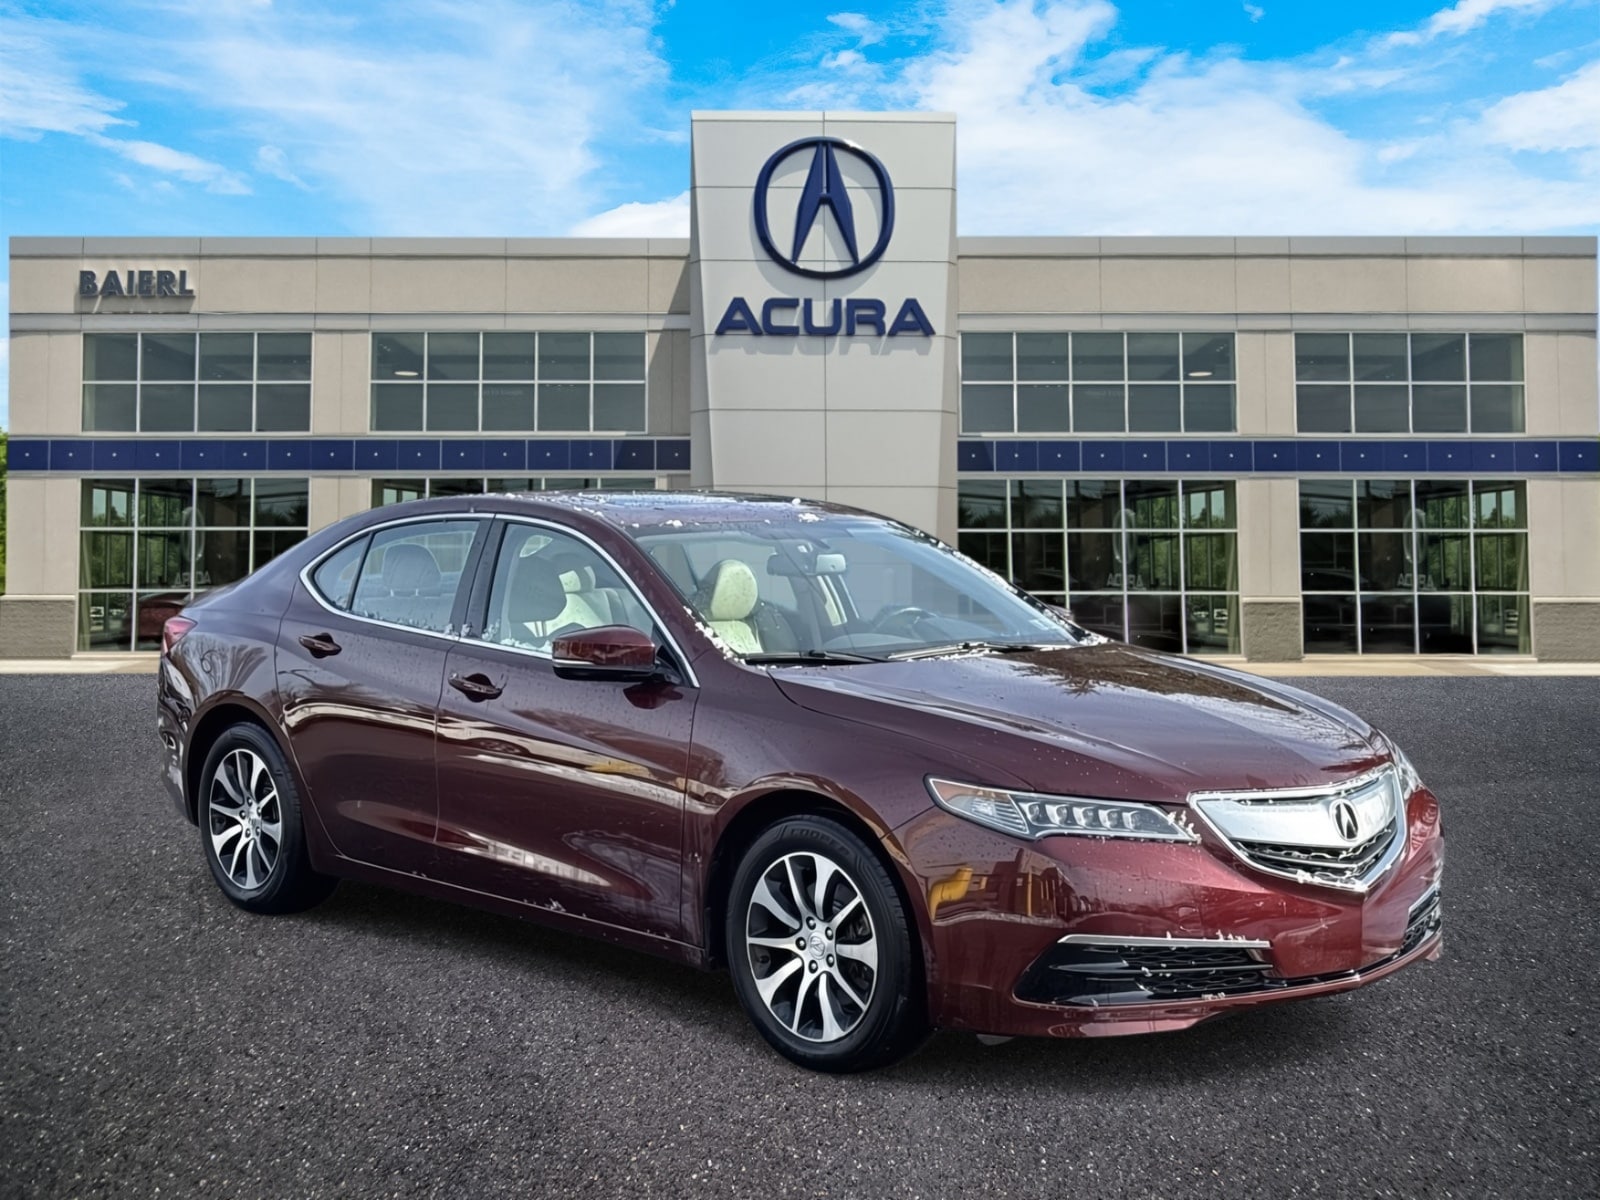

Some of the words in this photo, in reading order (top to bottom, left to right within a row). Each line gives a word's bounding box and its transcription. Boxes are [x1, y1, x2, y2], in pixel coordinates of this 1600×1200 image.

[79, 269, 195, 296] BAIERL
[714, 296, 936, 336] ACURA
[1106, 573, 1144, 587] ACRA
[1397, 573, 1435, 587] ACRA
